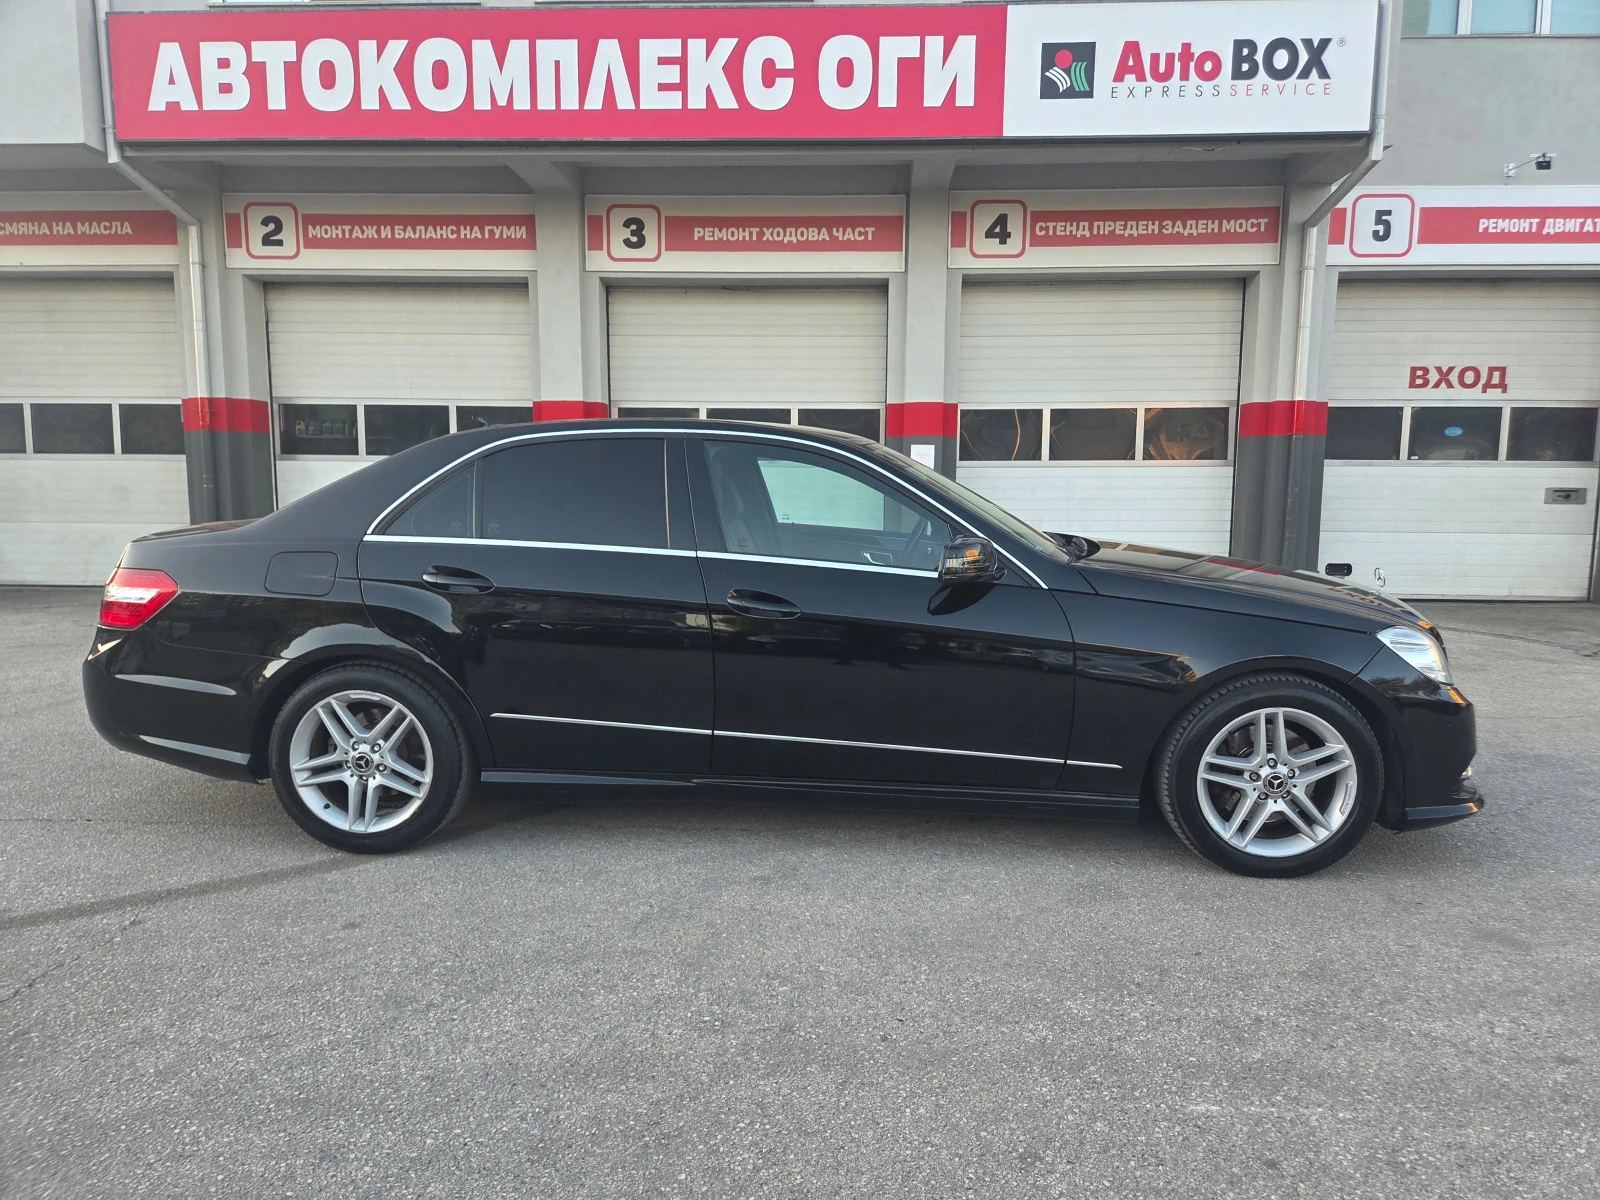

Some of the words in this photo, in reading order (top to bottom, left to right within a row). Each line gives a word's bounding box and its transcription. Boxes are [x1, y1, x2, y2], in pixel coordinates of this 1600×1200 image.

[147, 36, 795, 112] АВТОКОМПЛЕКС
[817, 34, 978, 110] ОГИ
[1112, 40, 1223, 83] Auto
[1230, 37, 1332, 81] BOX
[52, 222, 75, 235] НА
[77, 221, 133, 235] МАСЛА
[260, 215, 284, 247] 2
[308, 224, 378, 238] МОНТАЖ
[380, 225, 392, 238] И
[394, 225, 458, 240] БАЛАНС
[460, 225, 481, 239] НА
[484, 225, 527, 239] ГУМИ
[622, 217, 647, 250] 3
[694, 227, 760, 241] РЕМОНТ
[762, 227, 830, 243] ХОДОВА
[832, 227, 876, 241] ЧАСТ
[984, 213, 1012, 246] 4
[1035, 222, 1091, 238] СТЕНД
[1093, 220, 1160, 237] ПРЕДЕН
[1161, 219, 1218, 236] ЗАДЕН
[1221, 218, 1269, 233] МОСТ
[1371, 209, 1393, 243] 5
[1478, 218, 1541, 233] РЕМОНТ
[1408, 366, 1508, 393] ВХОД
